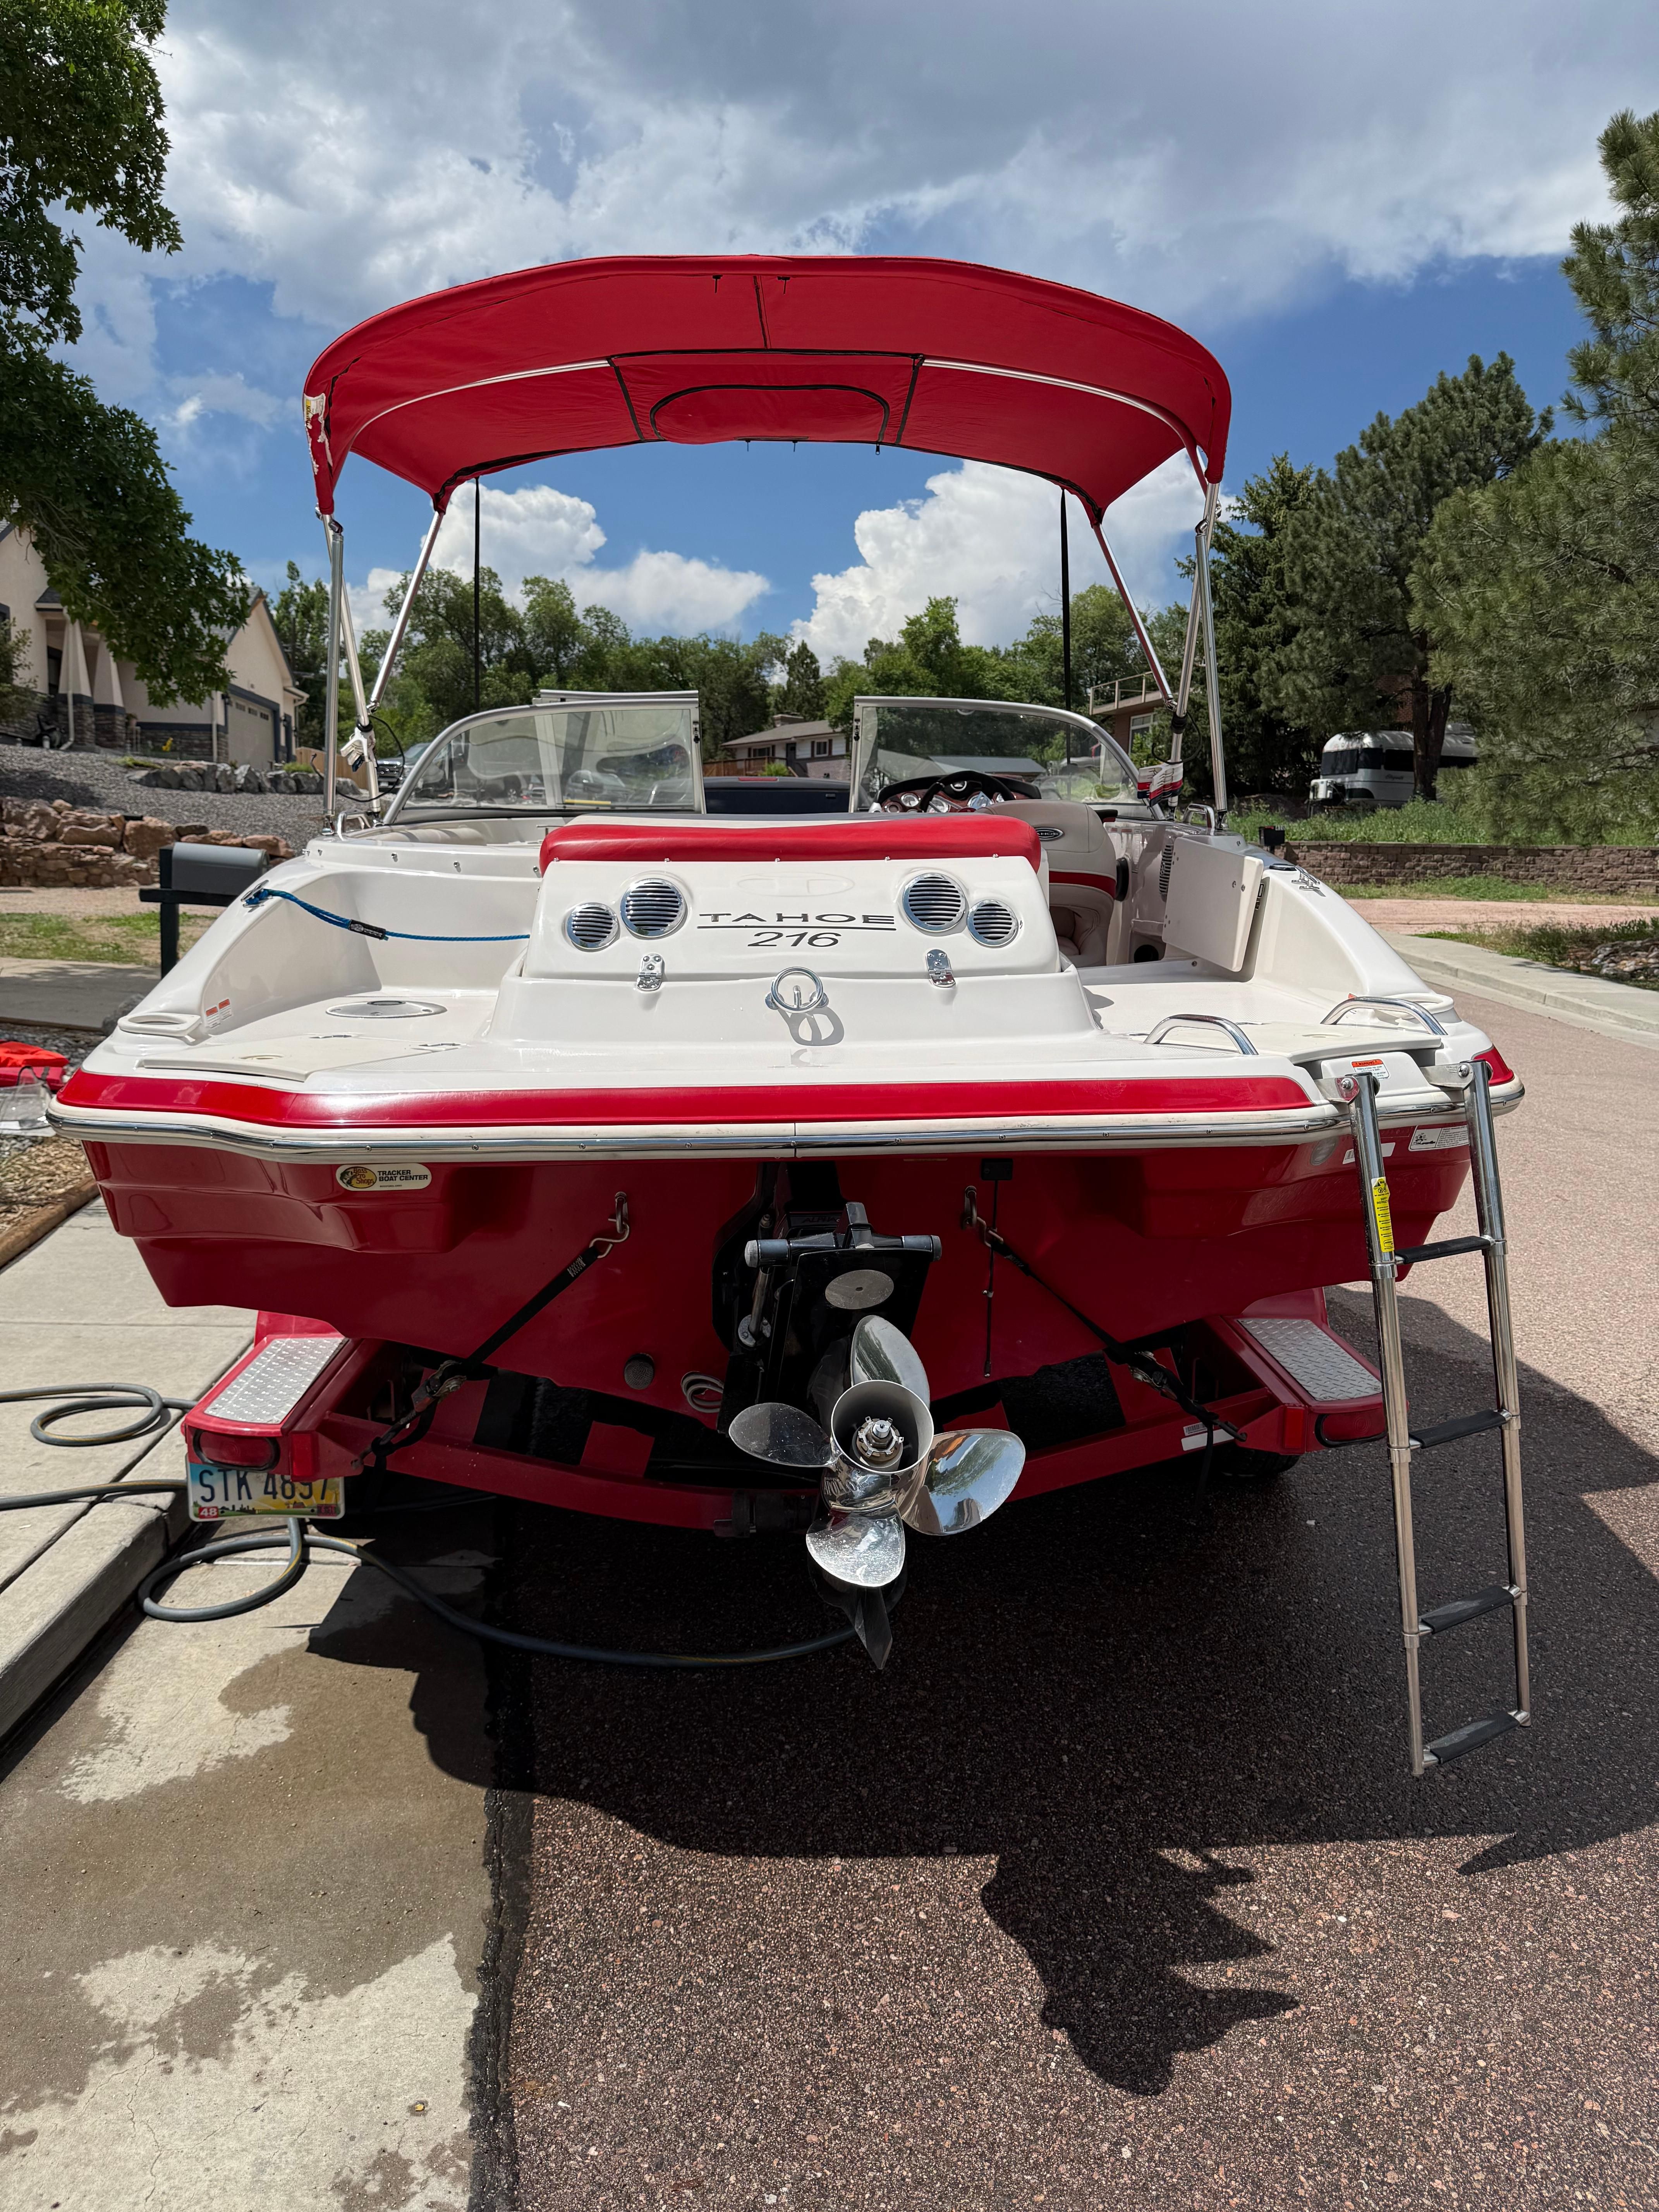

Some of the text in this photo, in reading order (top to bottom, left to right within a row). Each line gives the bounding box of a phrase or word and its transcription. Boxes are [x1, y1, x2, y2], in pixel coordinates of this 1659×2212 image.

[699, 913, 895, 924] TAHOE
[747, 931, 842, 947] 216
[199, 1469, 252, 1502] STK
[199, 1508, 217, 1516] 48
